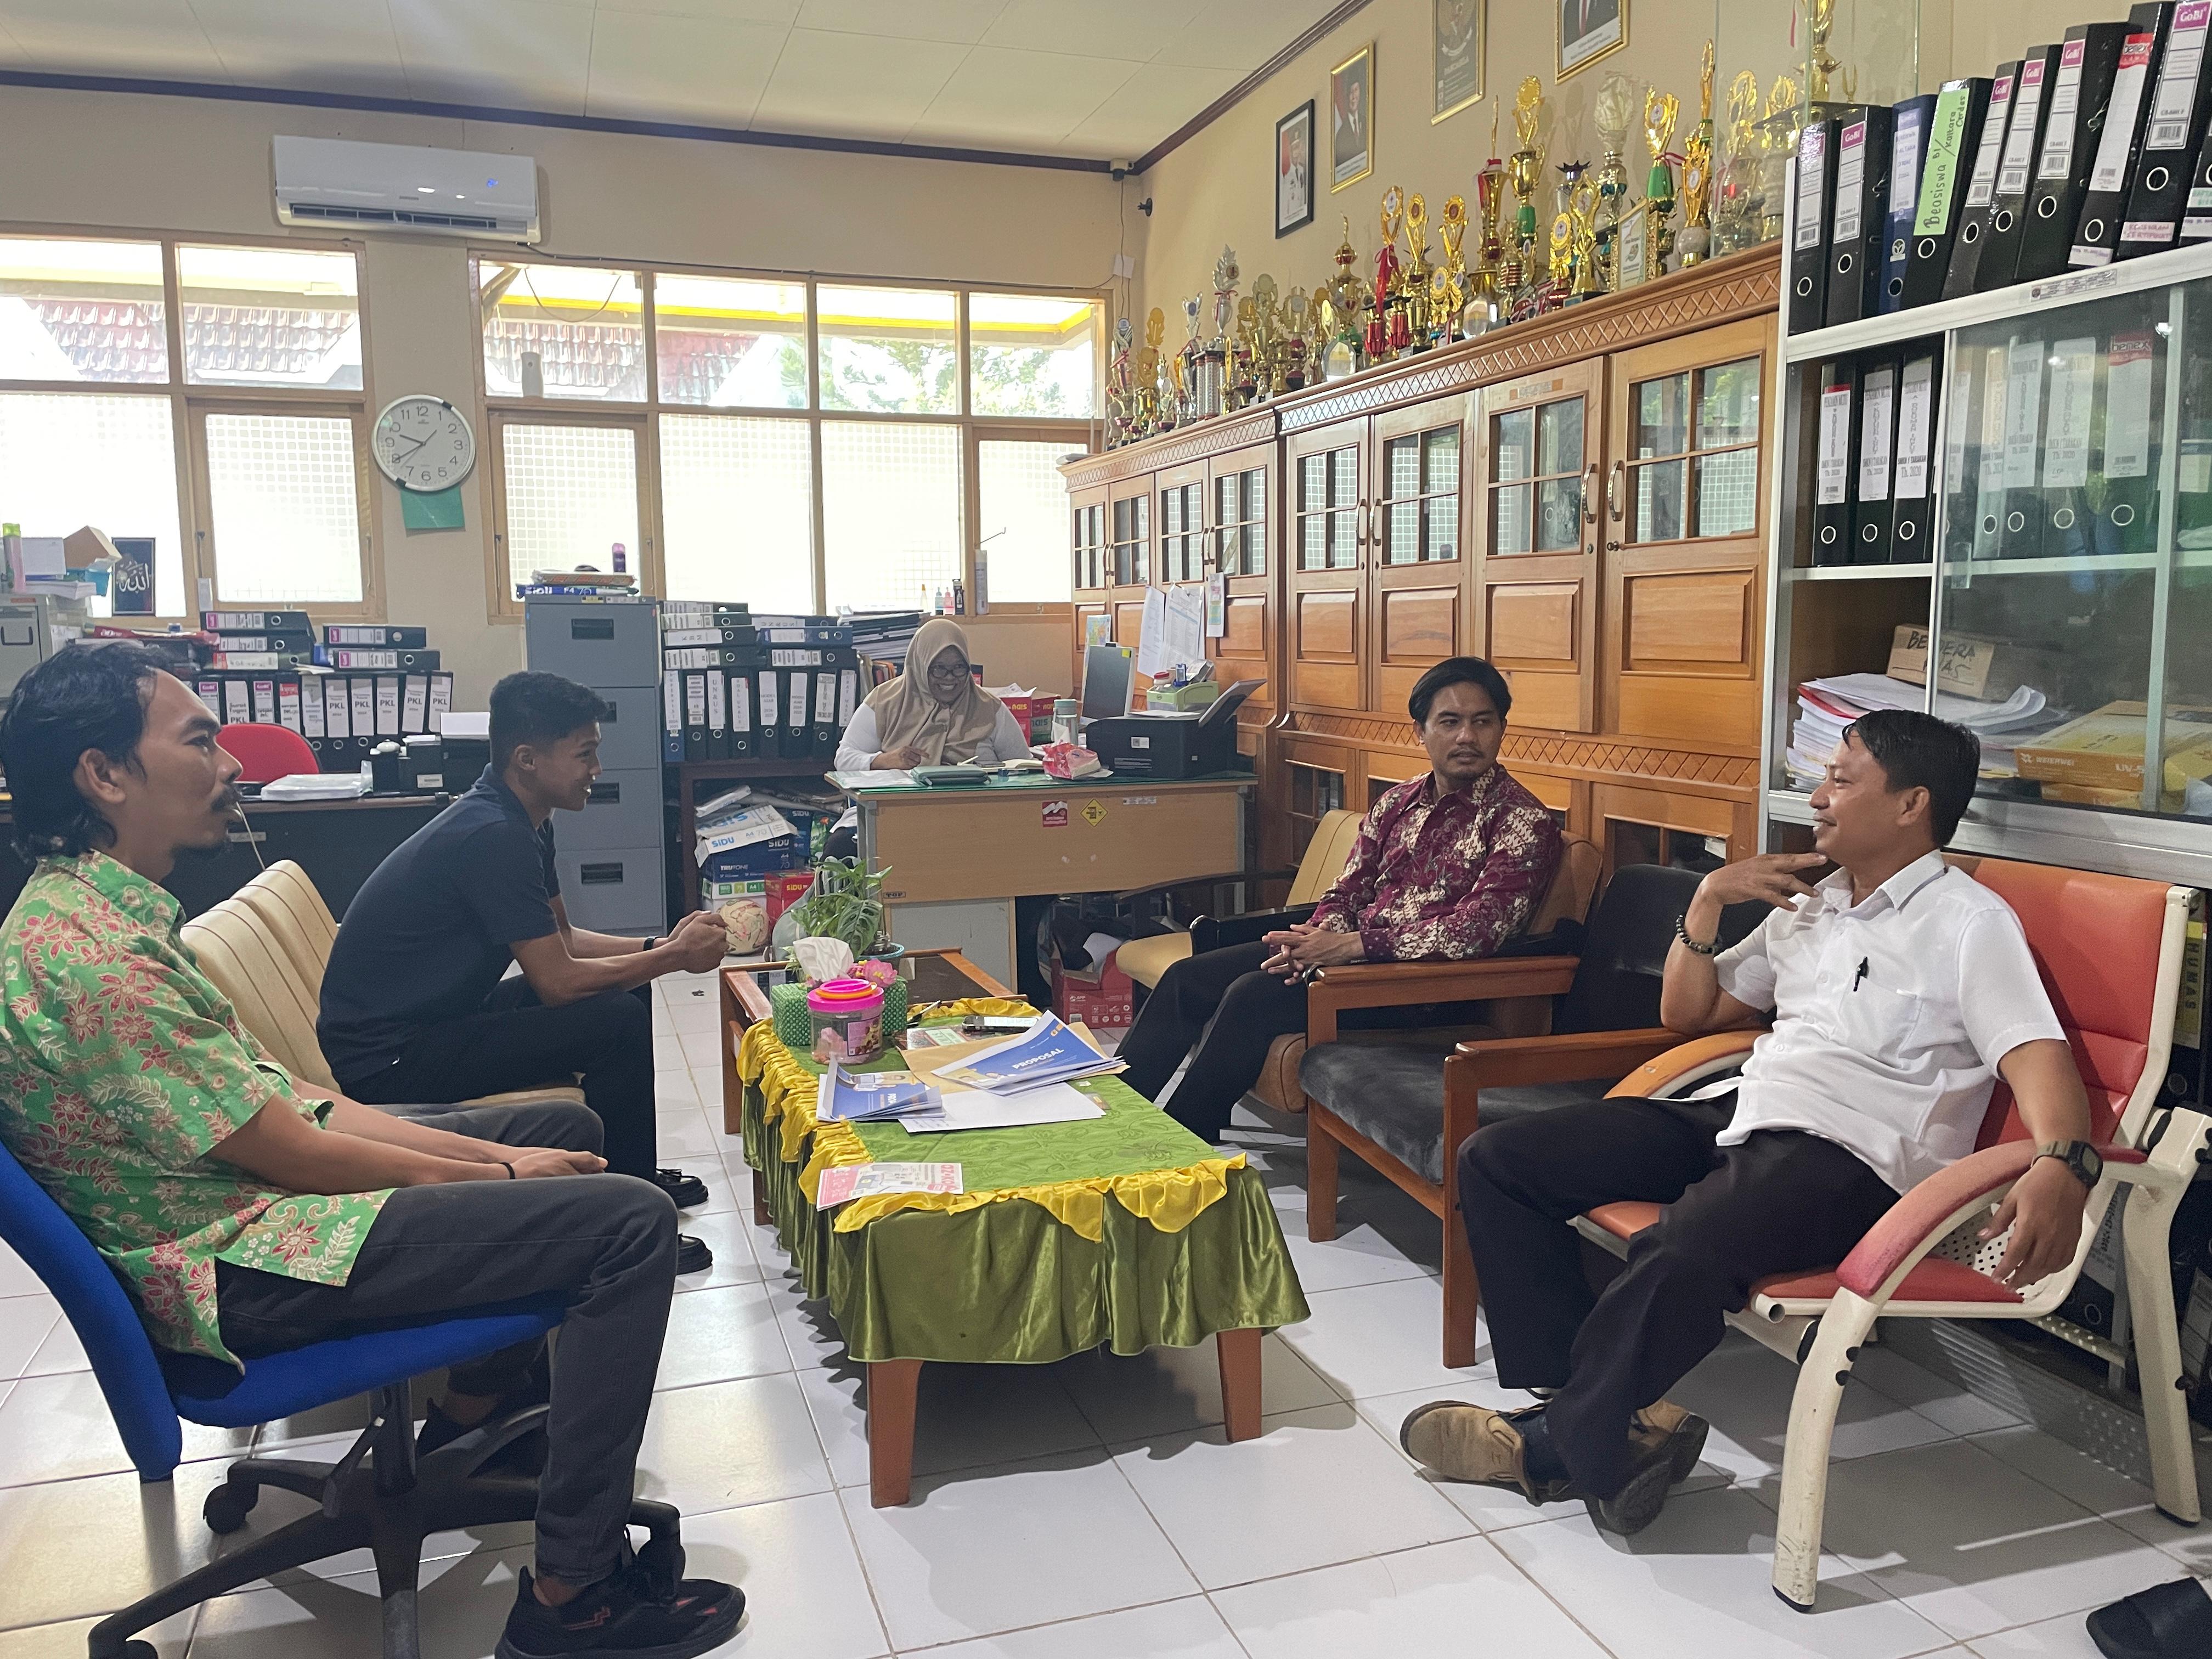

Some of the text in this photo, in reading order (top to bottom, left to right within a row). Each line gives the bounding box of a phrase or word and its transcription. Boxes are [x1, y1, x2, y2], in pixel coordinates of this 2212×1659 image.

[1923, 164, 1946, 228] Beasiswa
[400, 409, 410, 420] 11
[416, 405, 428, 416] 12
[438, 410, 442, 421] 1
[390, 422, 400, 433] 10
[448, 424, 457, 434] 2
[385, 437, 394, 448] 9
[454, 440, 463, 450] 3
[449, 455, 458, 465] 4
[405, 466, 414, 476] 7
[421, 471, 431, 481] 6
[438, 467, 447, 477] 5
[1012, 1048, 1065, 1069] PROPOSAL
